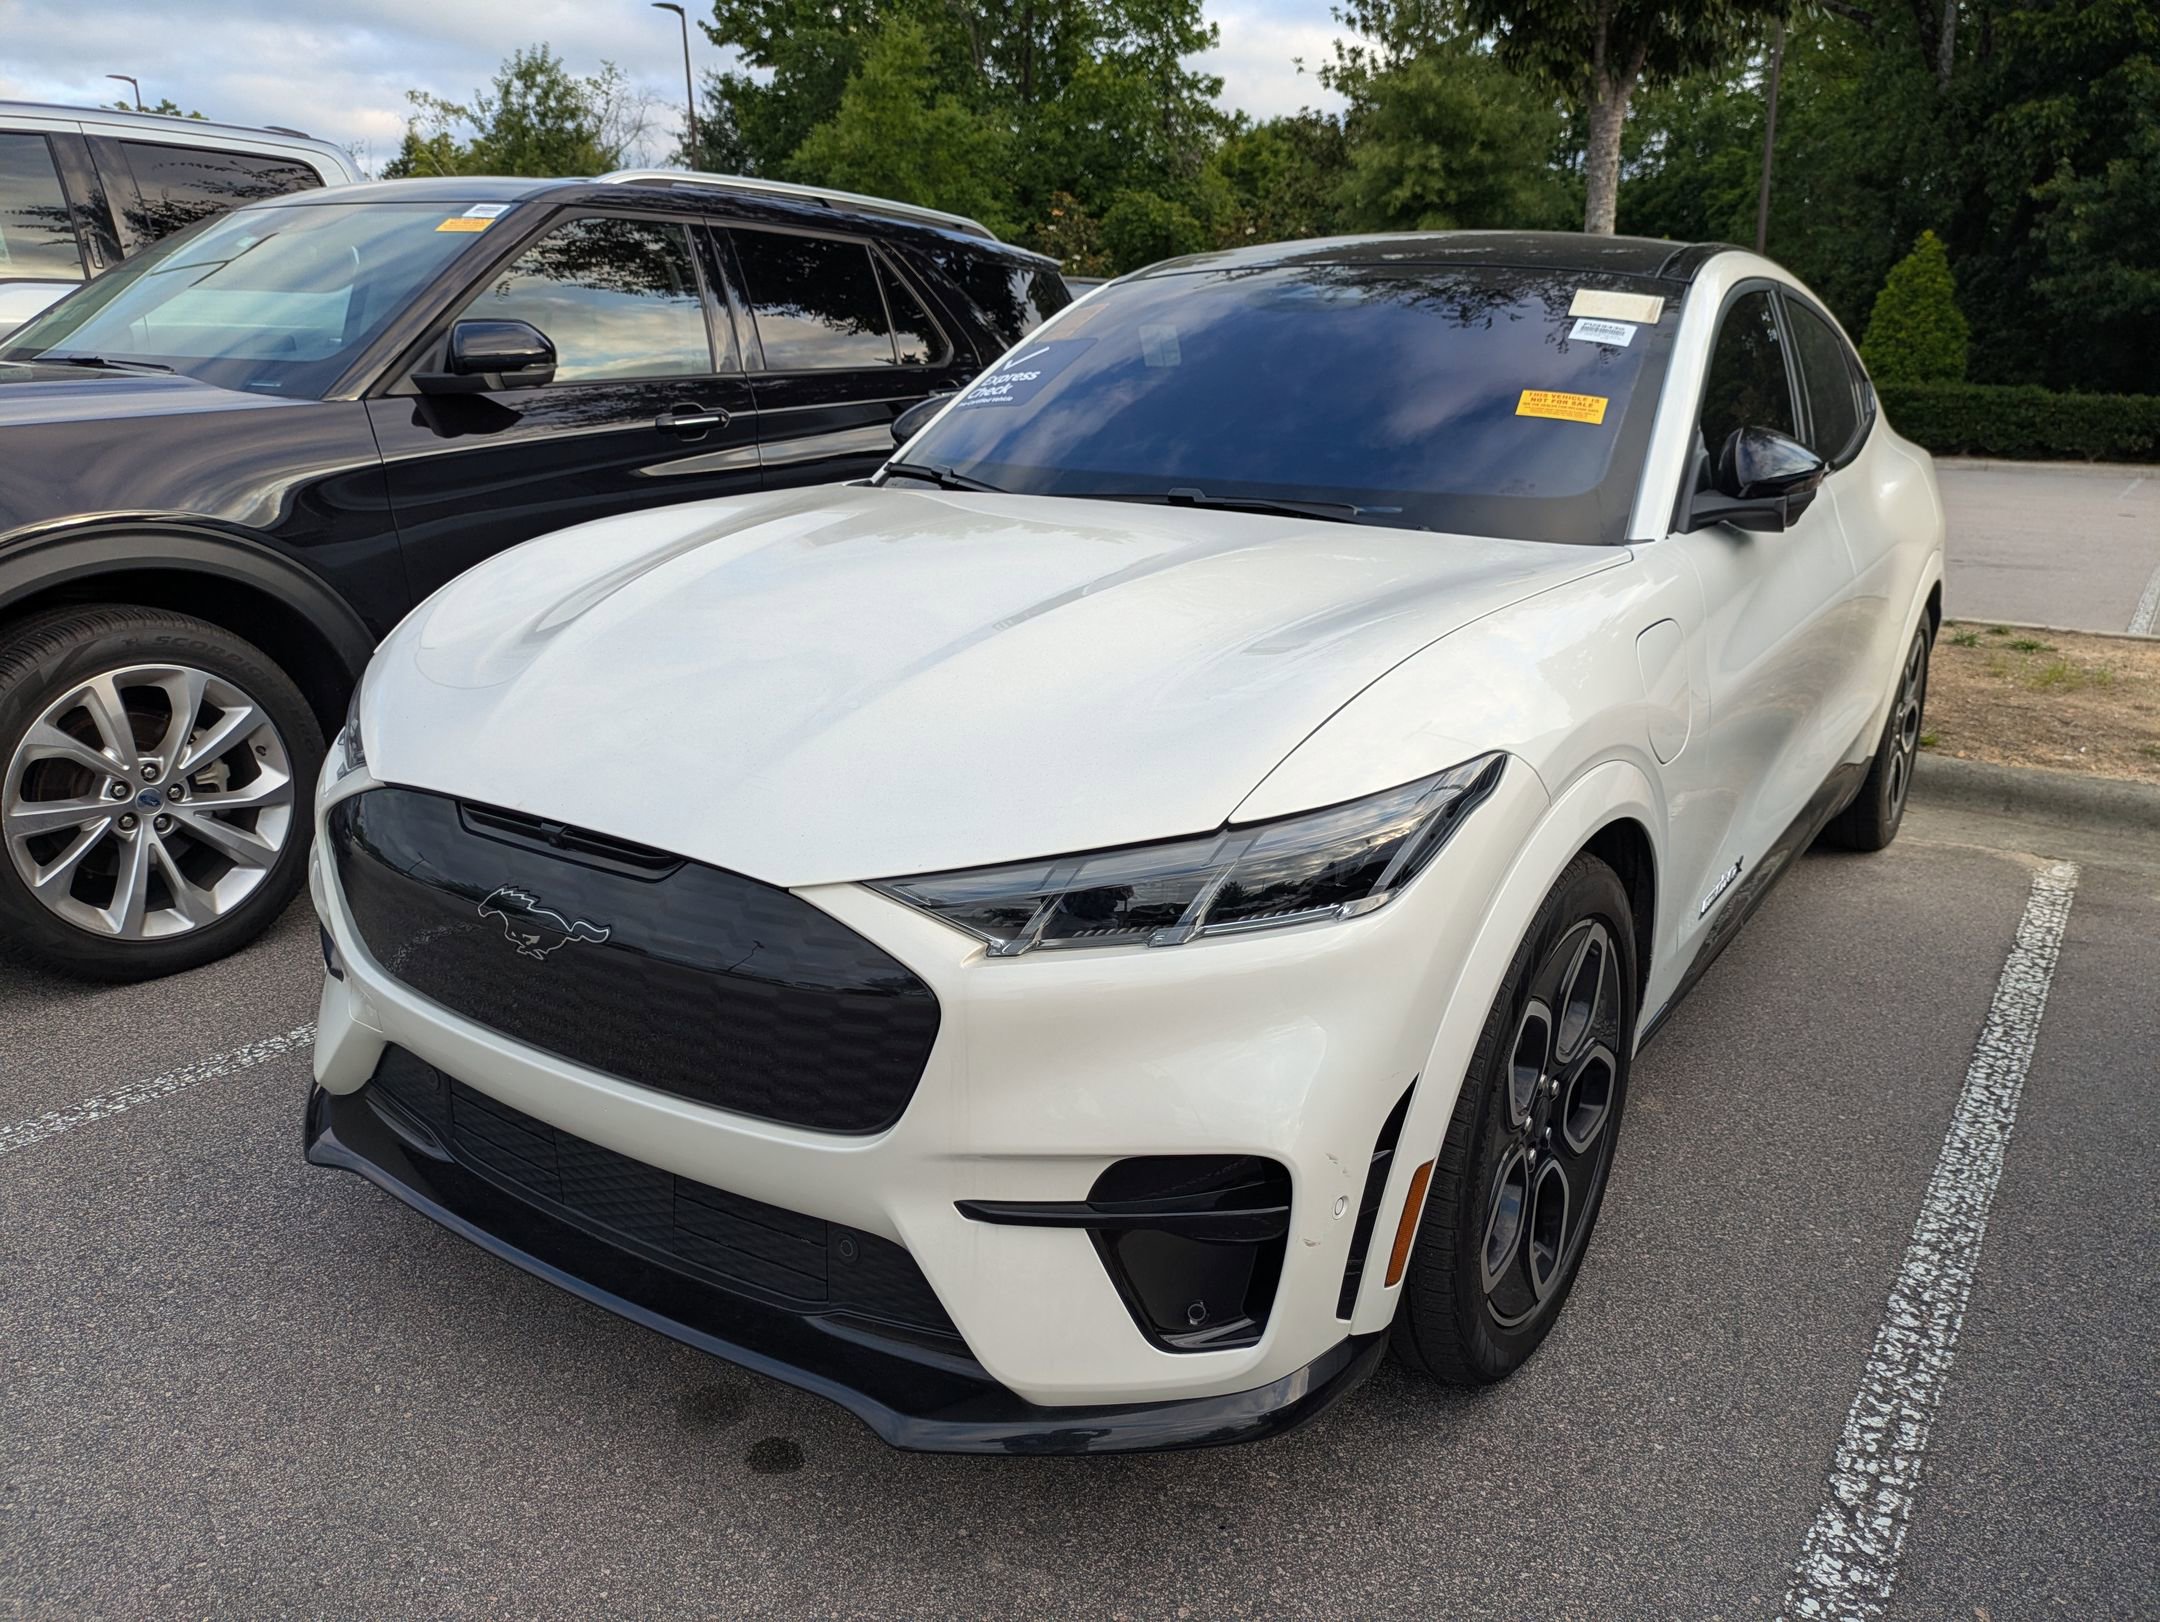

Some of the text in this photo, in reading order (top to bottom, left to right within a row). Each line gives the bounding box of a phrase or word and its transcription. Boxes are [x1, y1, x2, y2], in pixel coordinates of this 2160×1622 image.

[981, 371, 1041, 386] Express
[967, 383, 1013, 399] Check
[1551, 393, 1587, 402] VEHICLE
[150, 635, 276, 689] SCORPION
